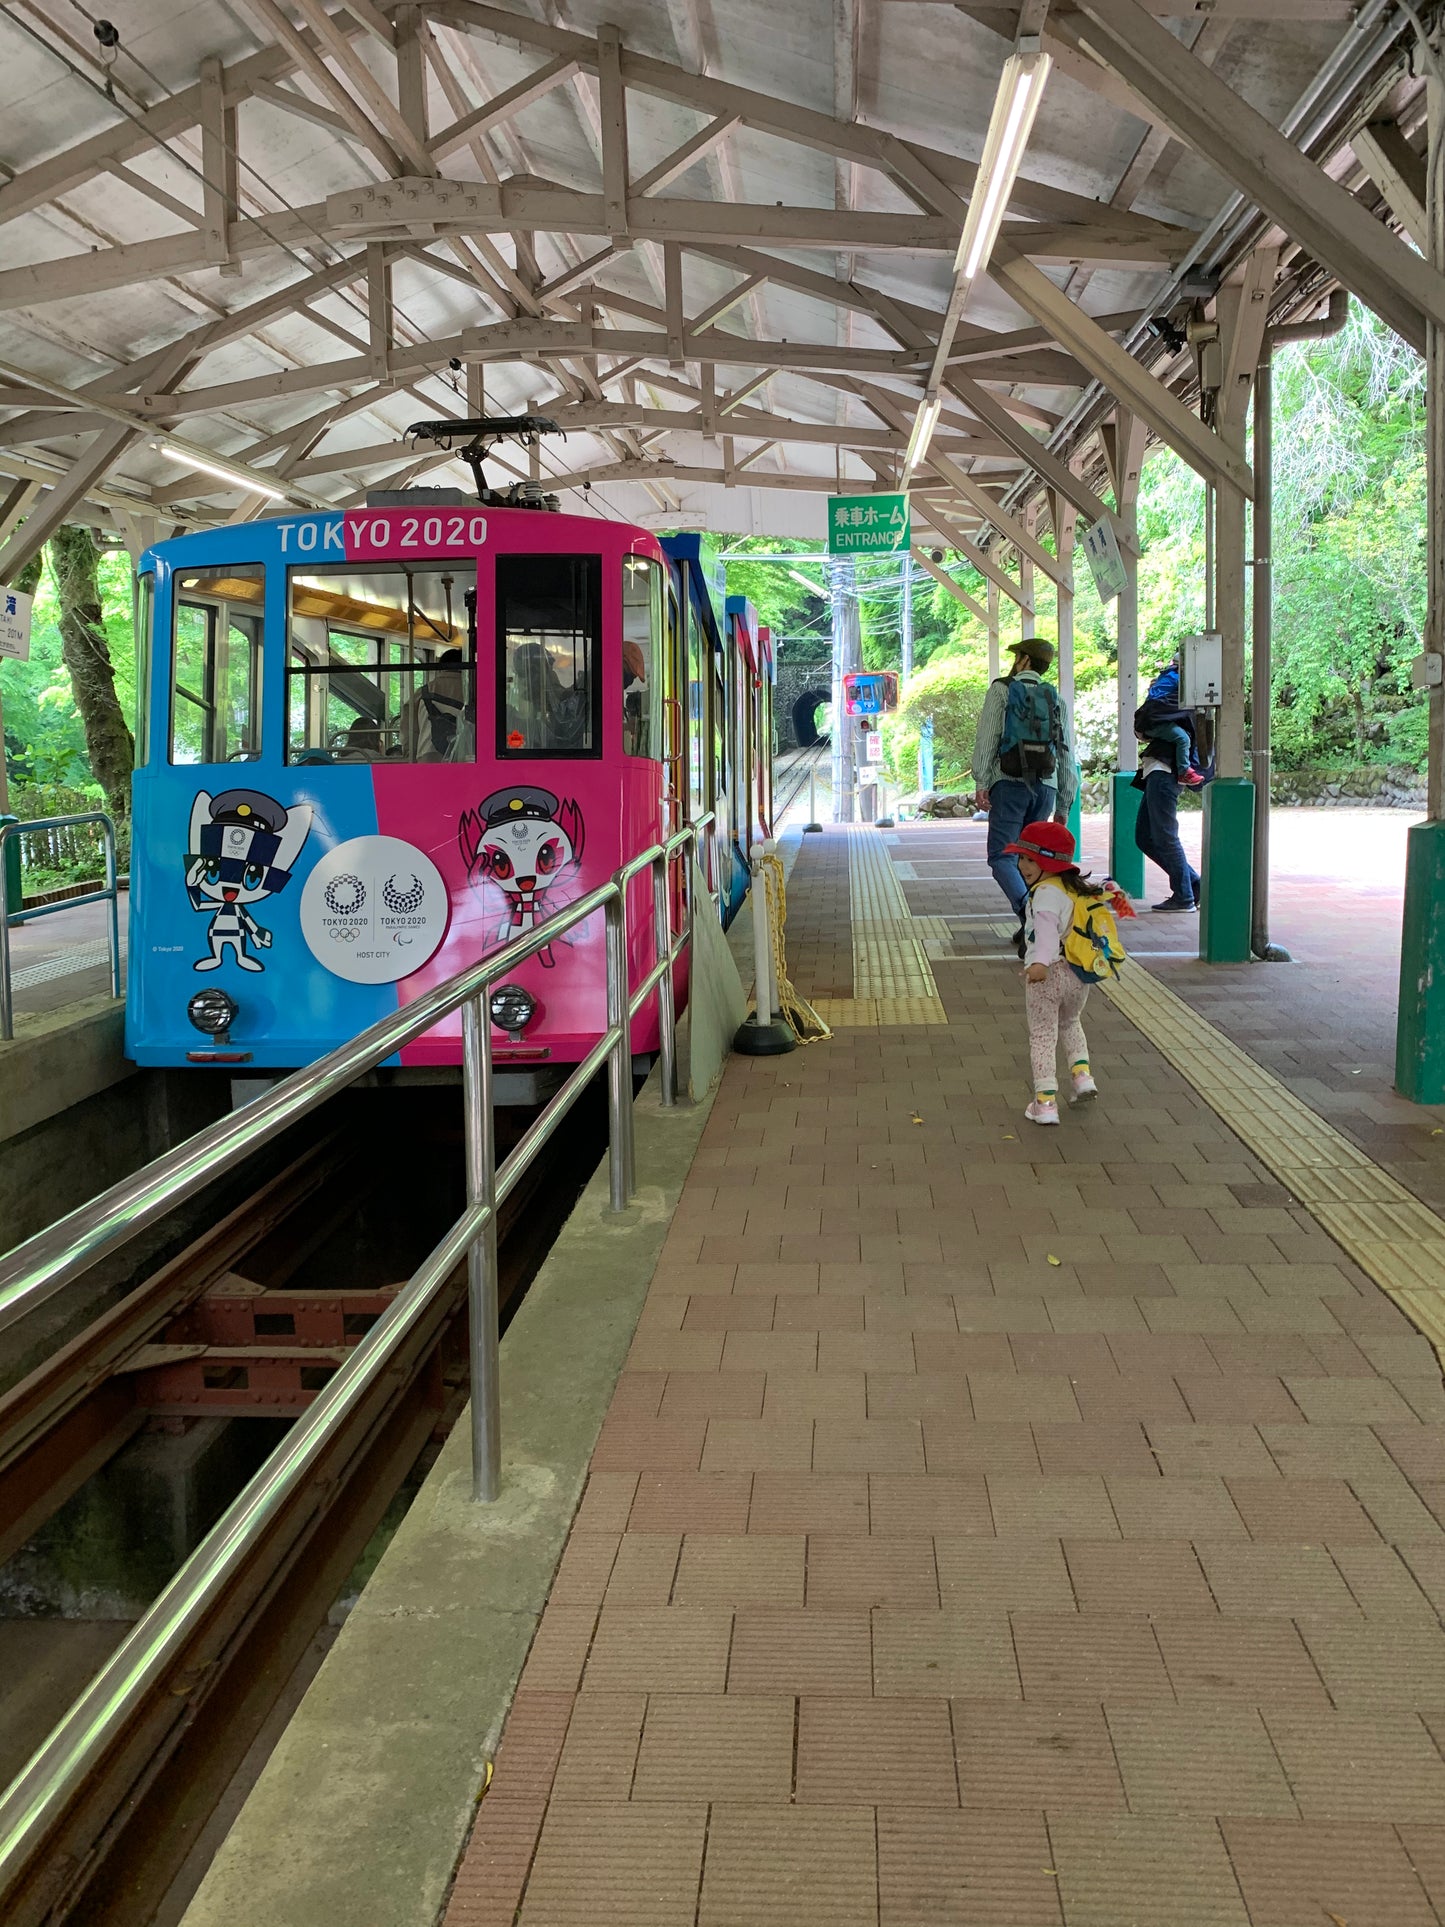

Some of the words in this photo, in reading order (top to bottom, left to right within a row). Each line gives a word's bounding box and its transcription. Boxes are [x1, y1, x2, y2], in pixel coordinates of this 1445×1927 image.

[834, 505, 905, 528] 乗車ホーム
[276, 519, 391, 552] TOKYO
[400, 517, 488, 547] 2020
[836, 530, 903, 547] ENTRANCE
[322, 918, 348, 926] TOKYO
[349, 918, 369, 926] 2020
[380, 917, 406, 925] TOKYO
[407, 917, 427, 925] 2020
[356, 951, 374, 959] HOST
[375, 951, 391, 959] CITY
